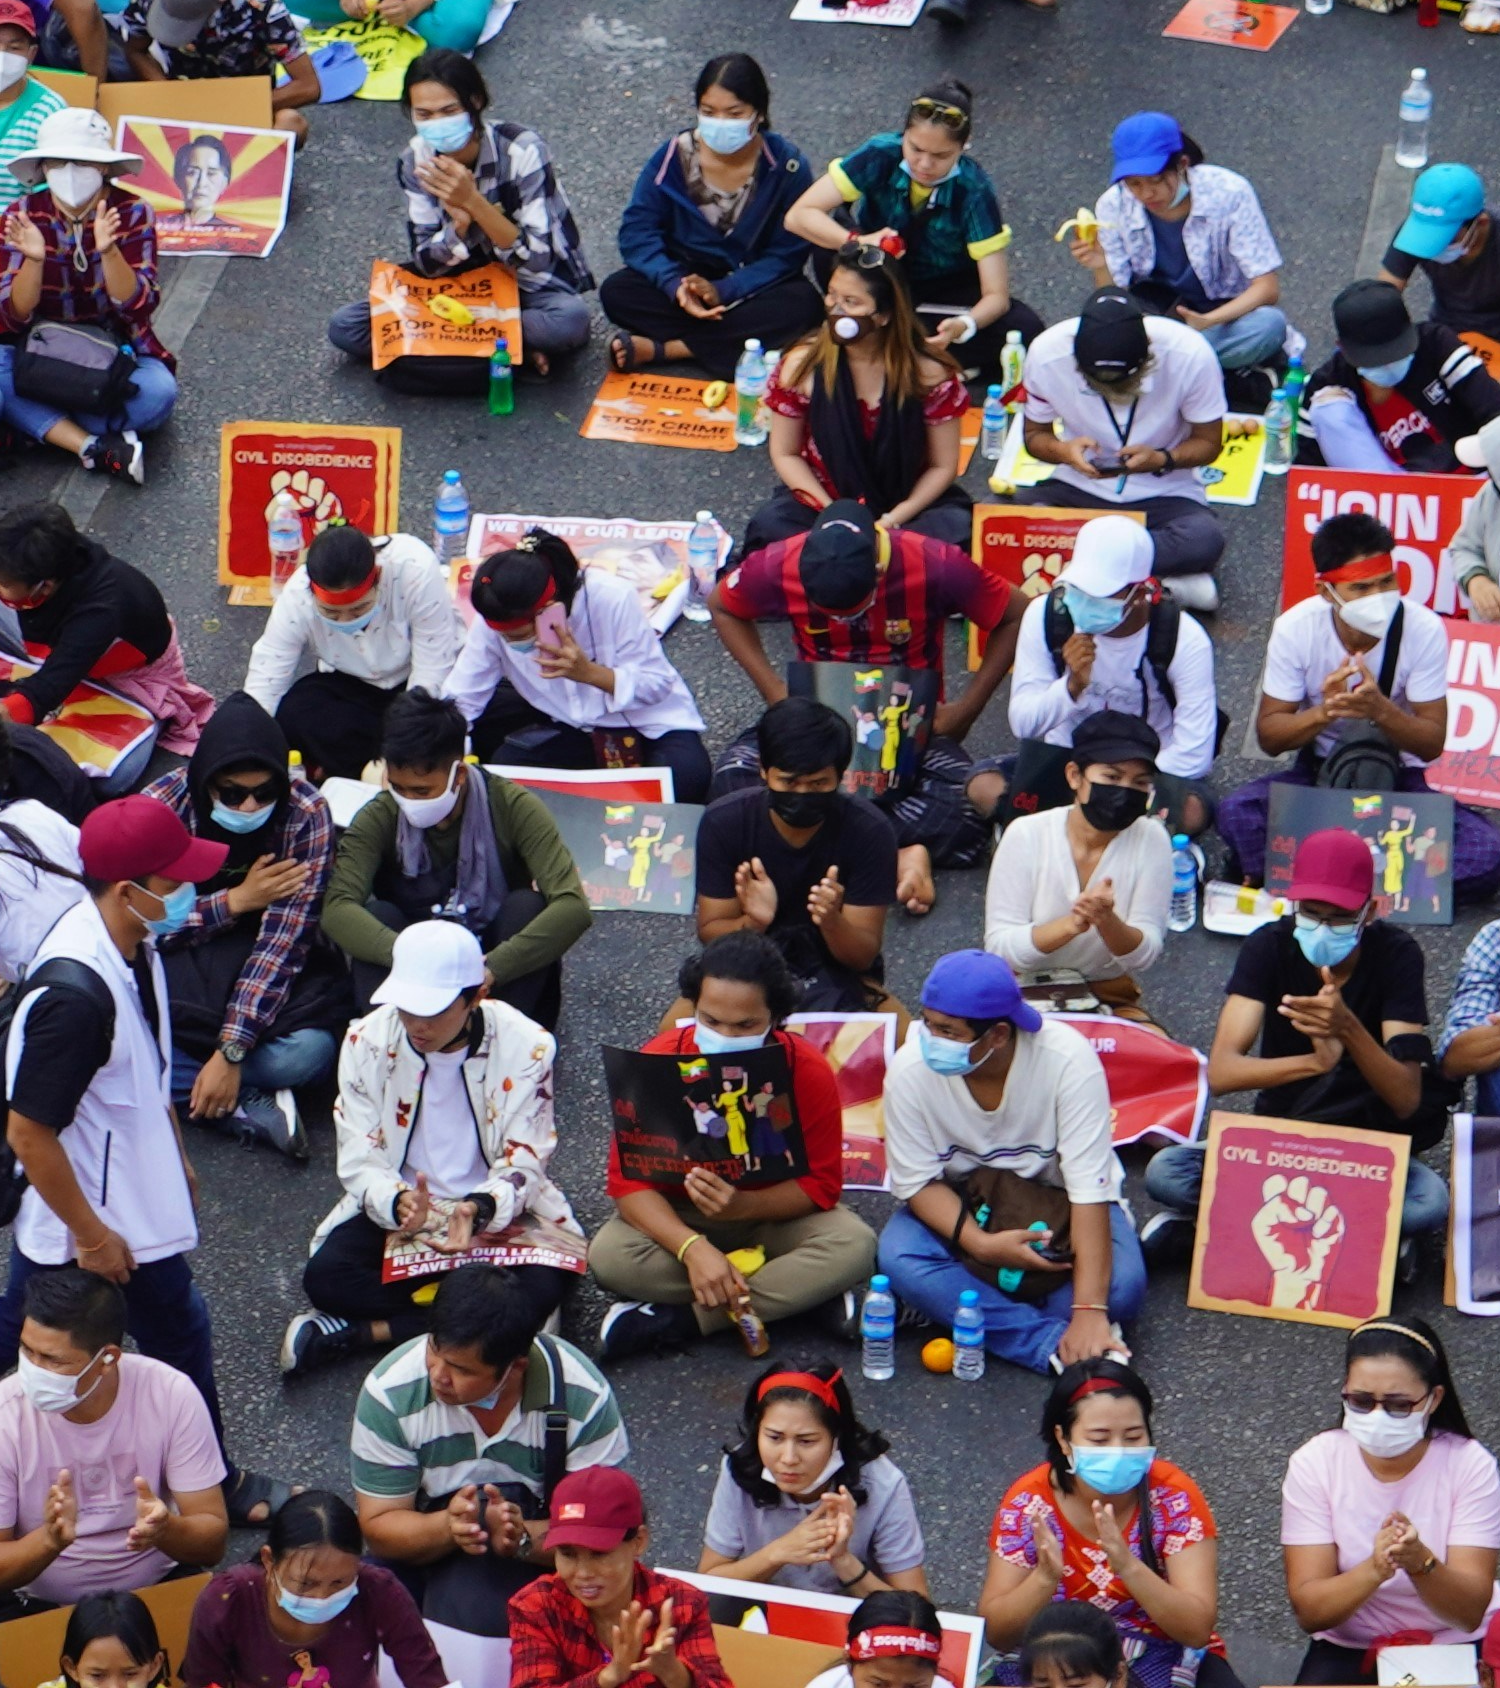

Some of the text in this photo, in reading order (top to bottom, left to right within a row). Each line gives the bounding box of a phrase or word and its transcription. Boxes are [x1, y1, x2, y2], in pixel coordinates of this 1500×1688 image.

[382, 319, 508, 338] STOP CRIME
[629, 380, 691, 395] HELP
[603, 413, 729, 435] STOP CRIME
[235, 450, 373, 468] CIVIL DISOBEDIENCE
[1222, 1145, 1388, 1182] CIVIL DISOBEDIENCE
[406, 1259, 450, 1276] SAVE
[493, 1255, 561, 1267] FUTURE
[471, 1247, 507, 1258] OUR
[509, 1248, 578, 1265] LEADER
